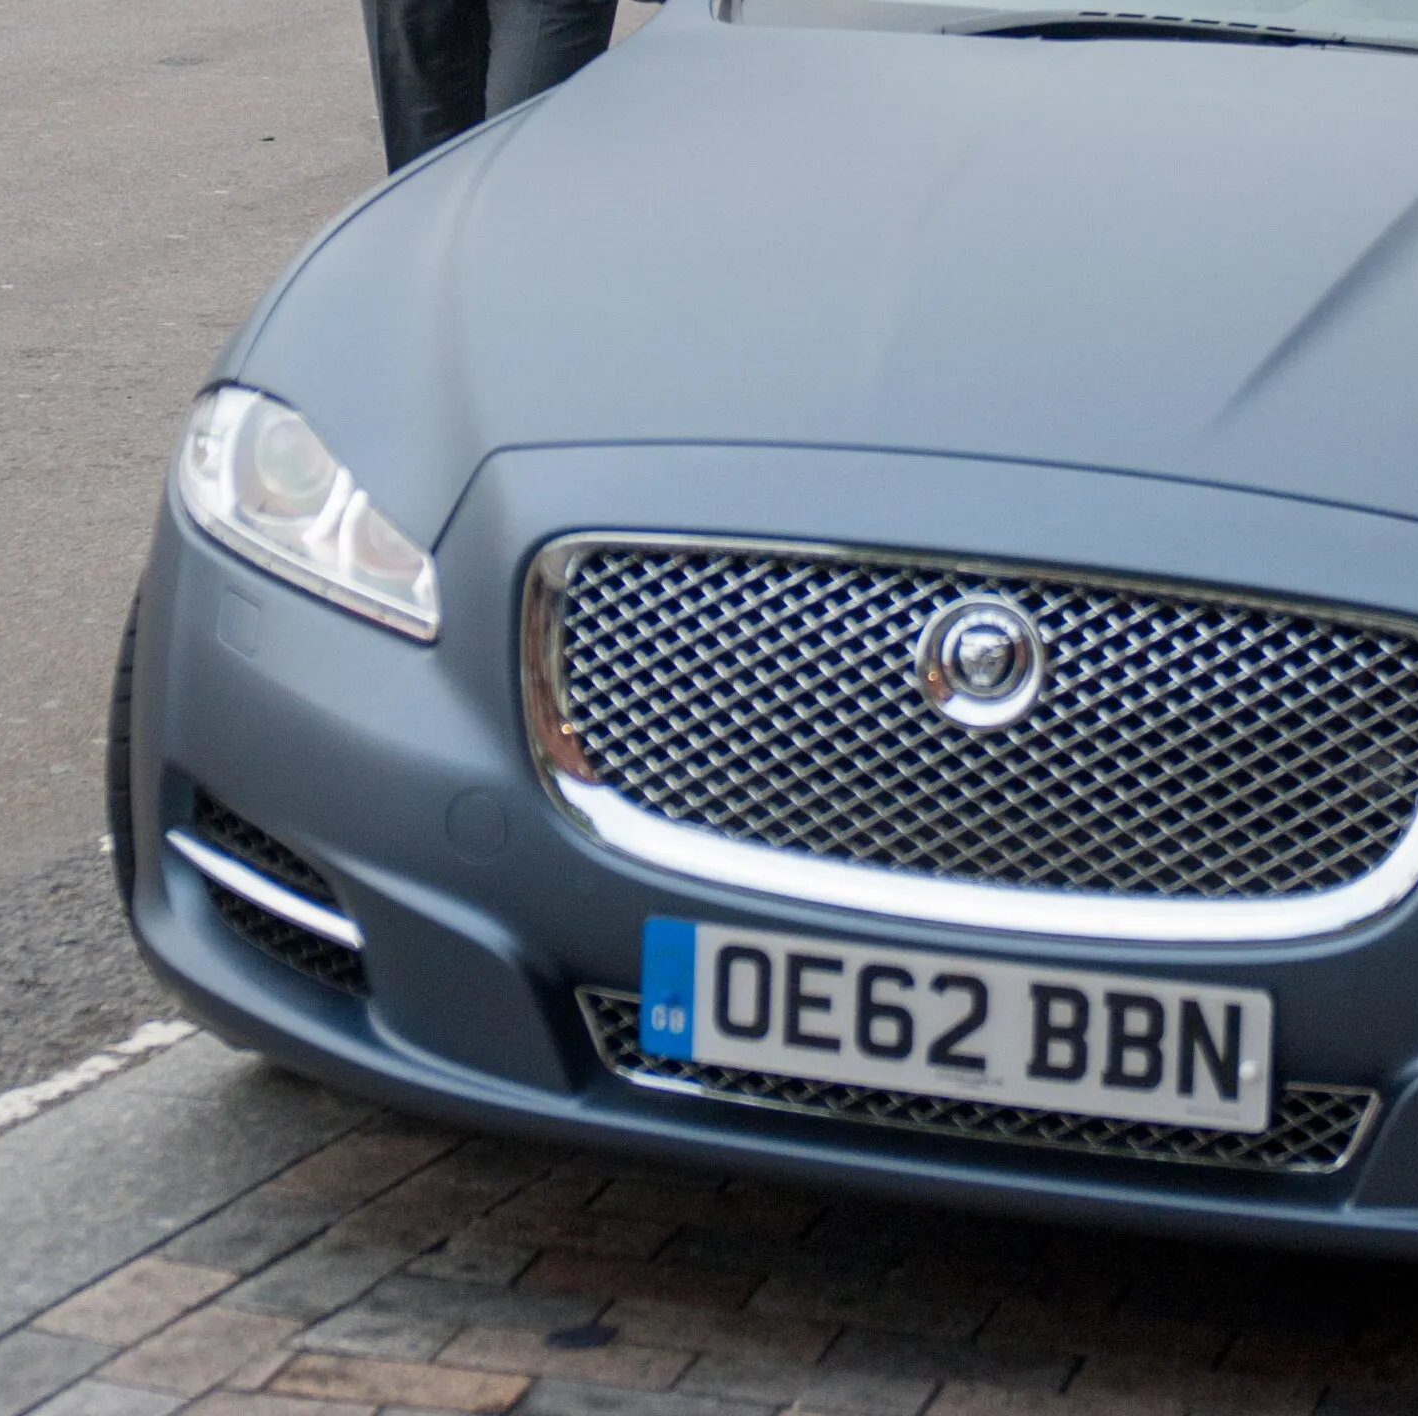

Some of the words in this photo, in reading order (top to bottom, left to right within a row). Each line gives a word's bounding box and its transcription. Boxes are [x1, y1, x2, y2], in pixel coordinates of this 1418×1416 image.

[651, 1003, 687, 1034] GB
[714, 944, 989, 1071] OE62
[1026, 981, 1243, 1103] BBN
